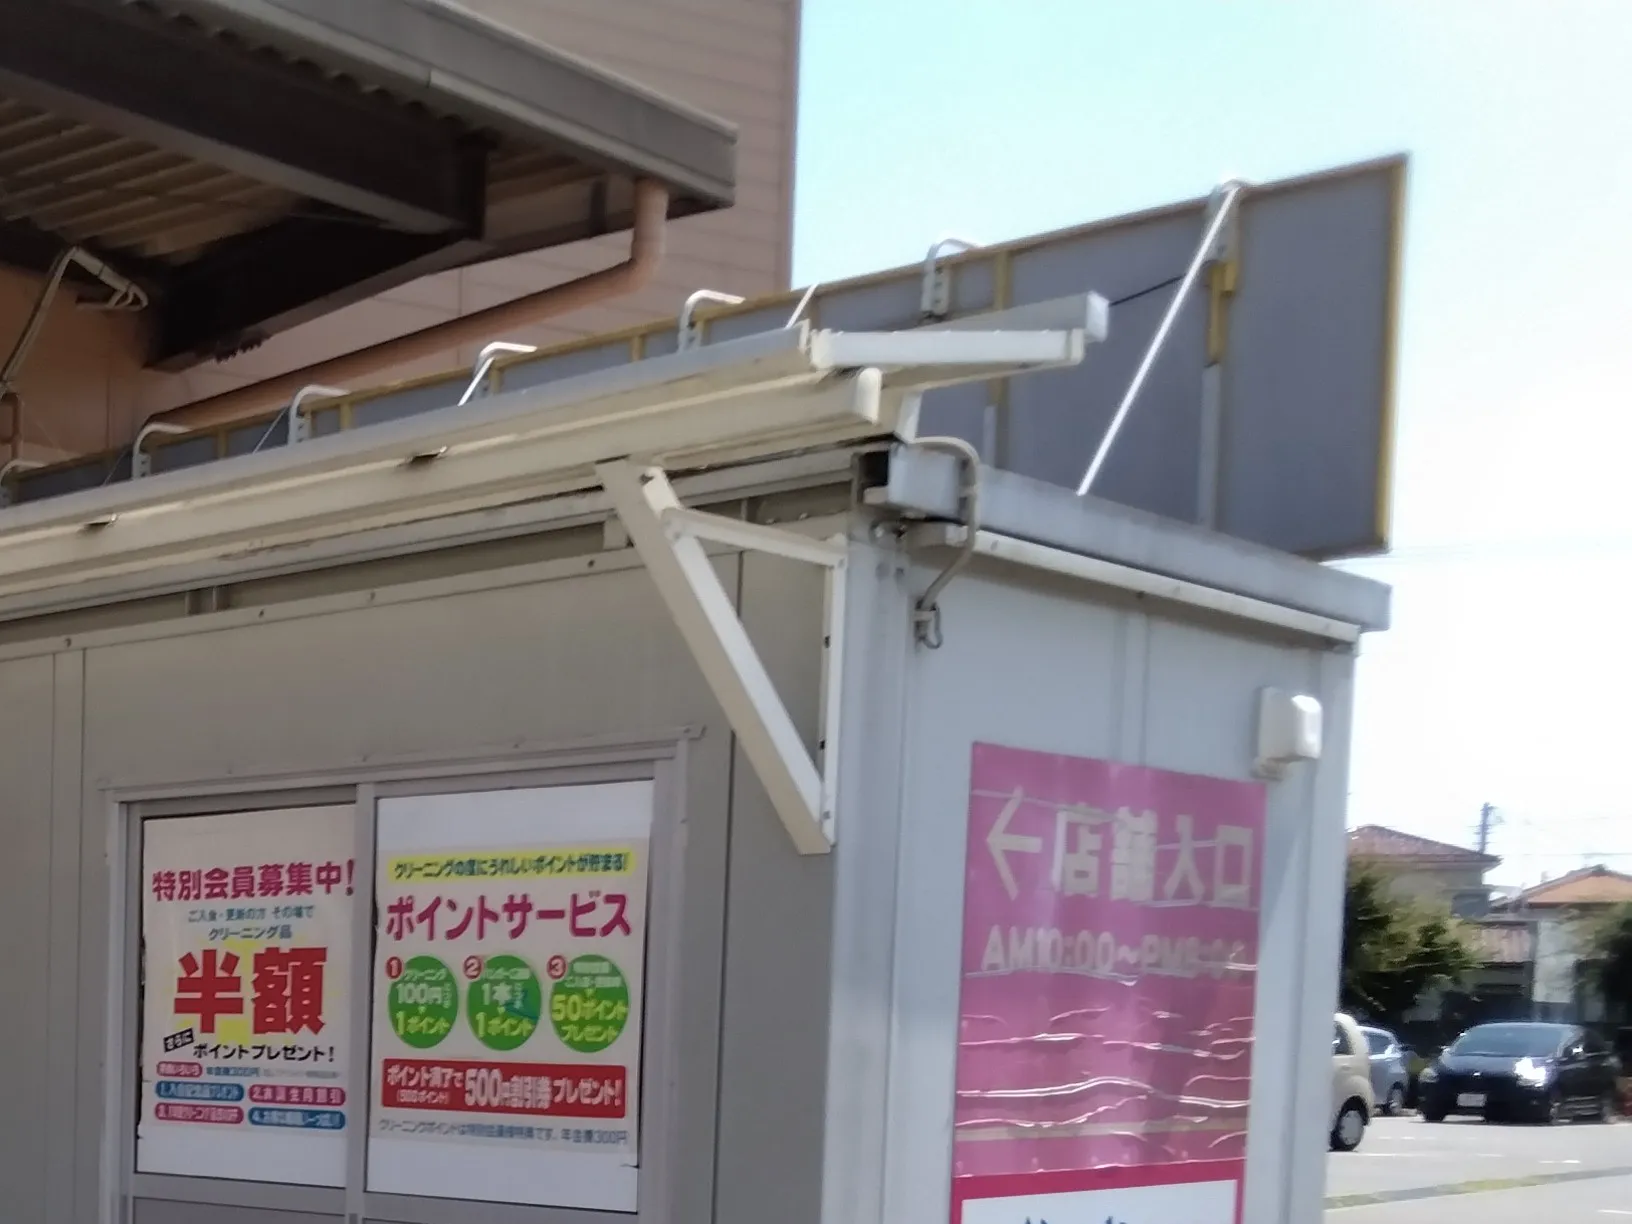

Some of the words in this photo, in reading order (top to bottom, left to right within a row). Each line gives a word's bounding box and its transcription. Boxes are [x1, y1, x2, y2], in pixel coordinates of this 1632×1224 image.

[152, 860, 355, 902] 特別会員募集中!
[386, 891, 632, 941] ポイントサービス
[208, 924, 294, 942] クリーニング品
[174, 947, 328, 1035] 半額
[551, 994, 628, 1021] 50ポイント
[396, 1011, 451, 1036] 1ポイント
[475, 1011, 534, 1038] 1ポイント
[193, 1043, 336, 1063] ポイントプレゼント!
